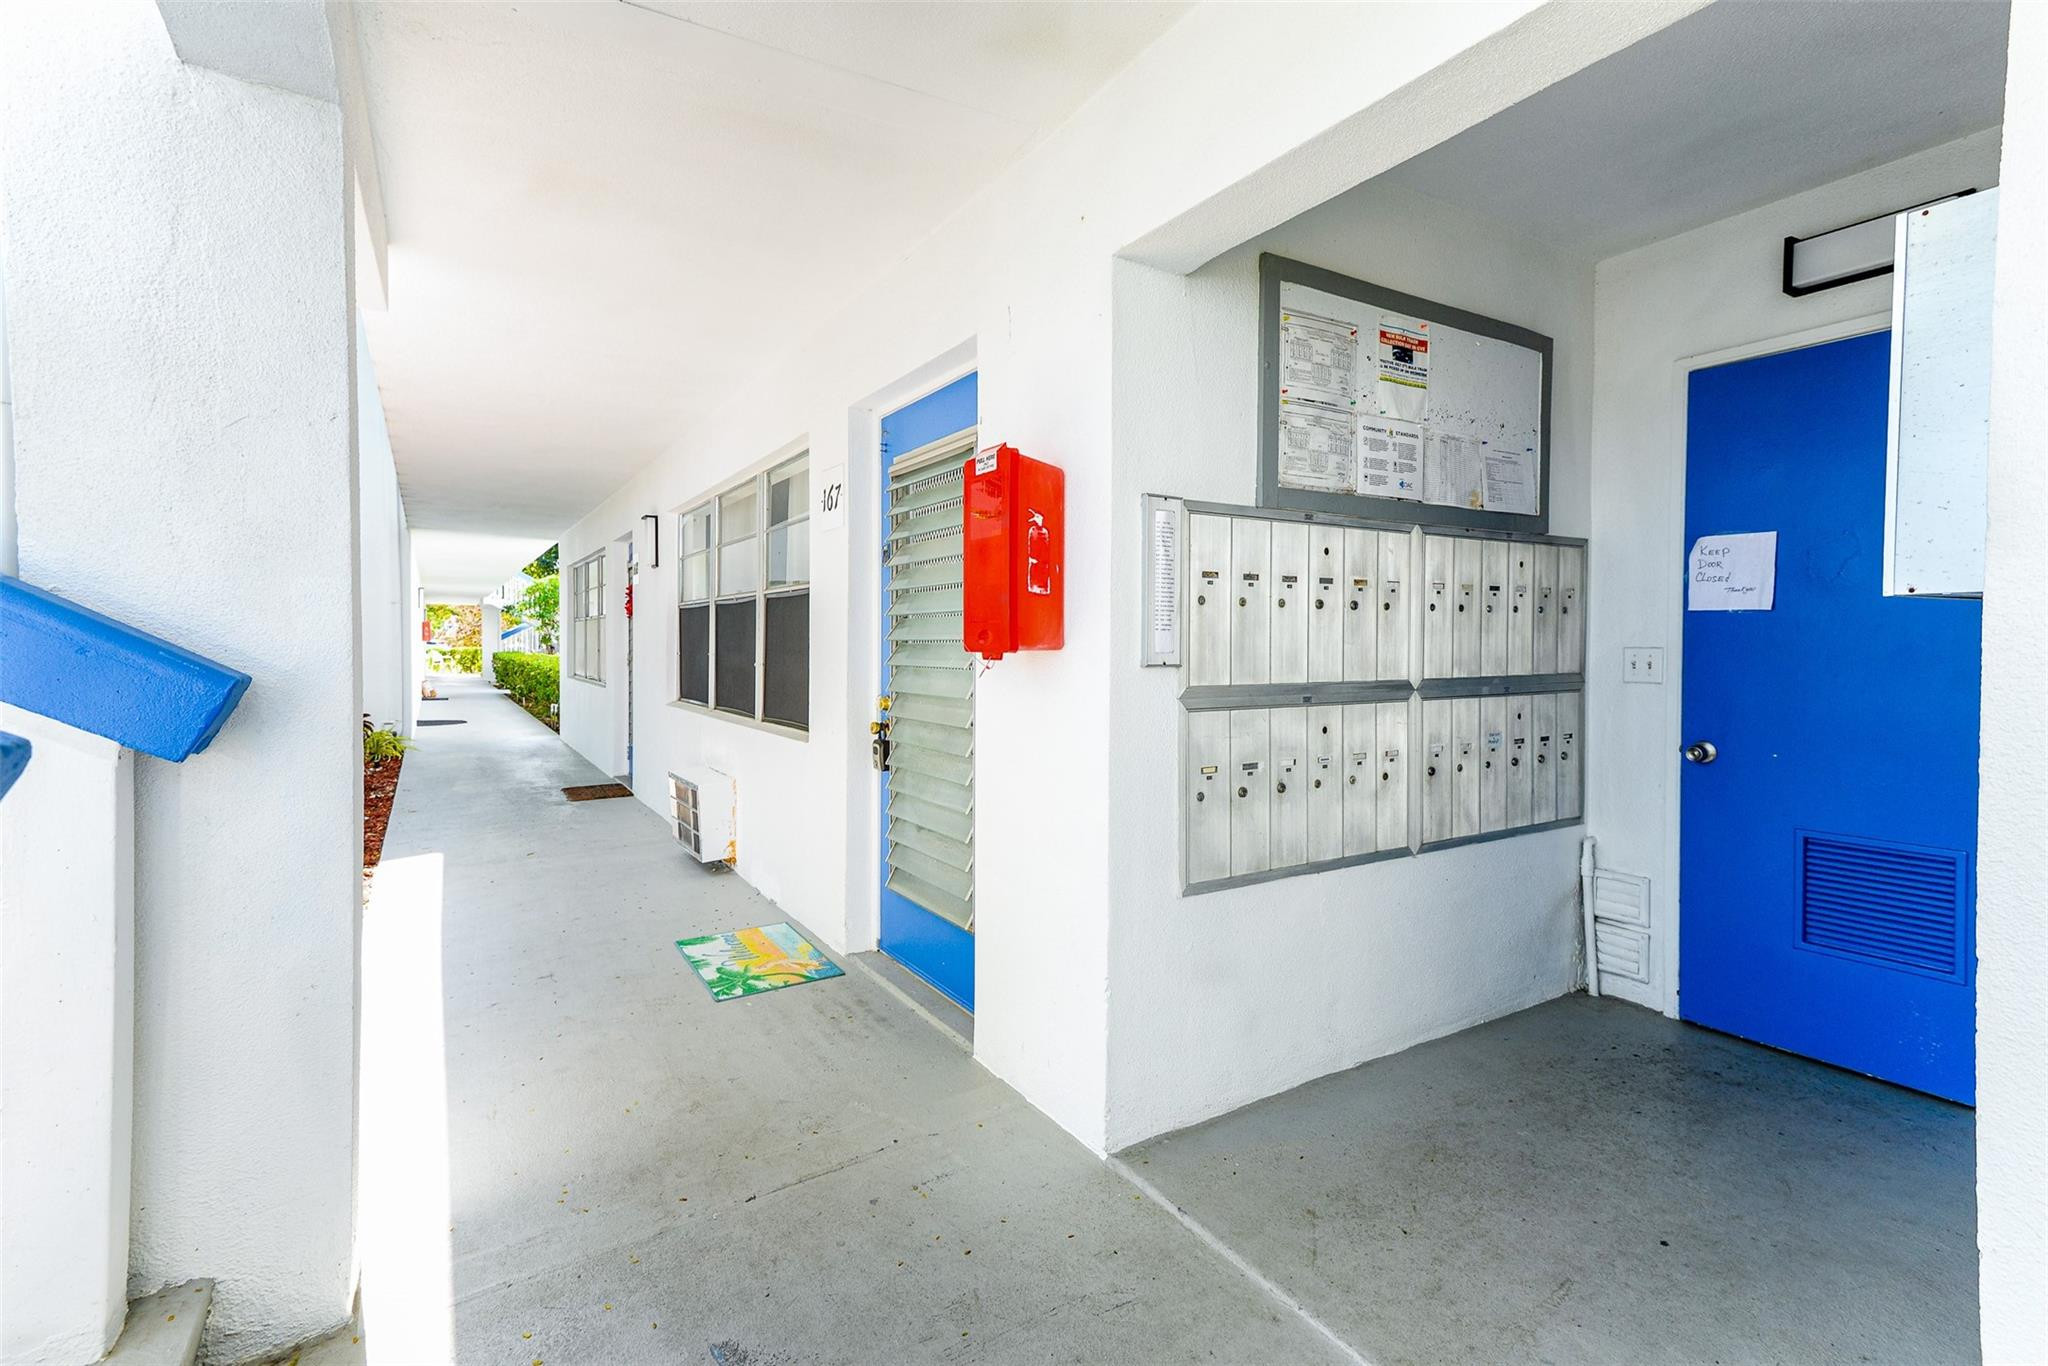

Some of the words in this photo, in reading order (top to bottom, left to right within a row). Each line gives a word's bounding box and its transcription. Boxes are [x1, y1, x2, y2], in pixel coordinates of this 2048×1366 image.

[1362, 425, 1387, 433] COMMUNITY
[1395, 431, 1419, 439] STANDARDS
[822, 483, 842, 512] 167
[1700, 545, 1730, 557] KEEP
[1697, 559, 1724, 570] DOOR
